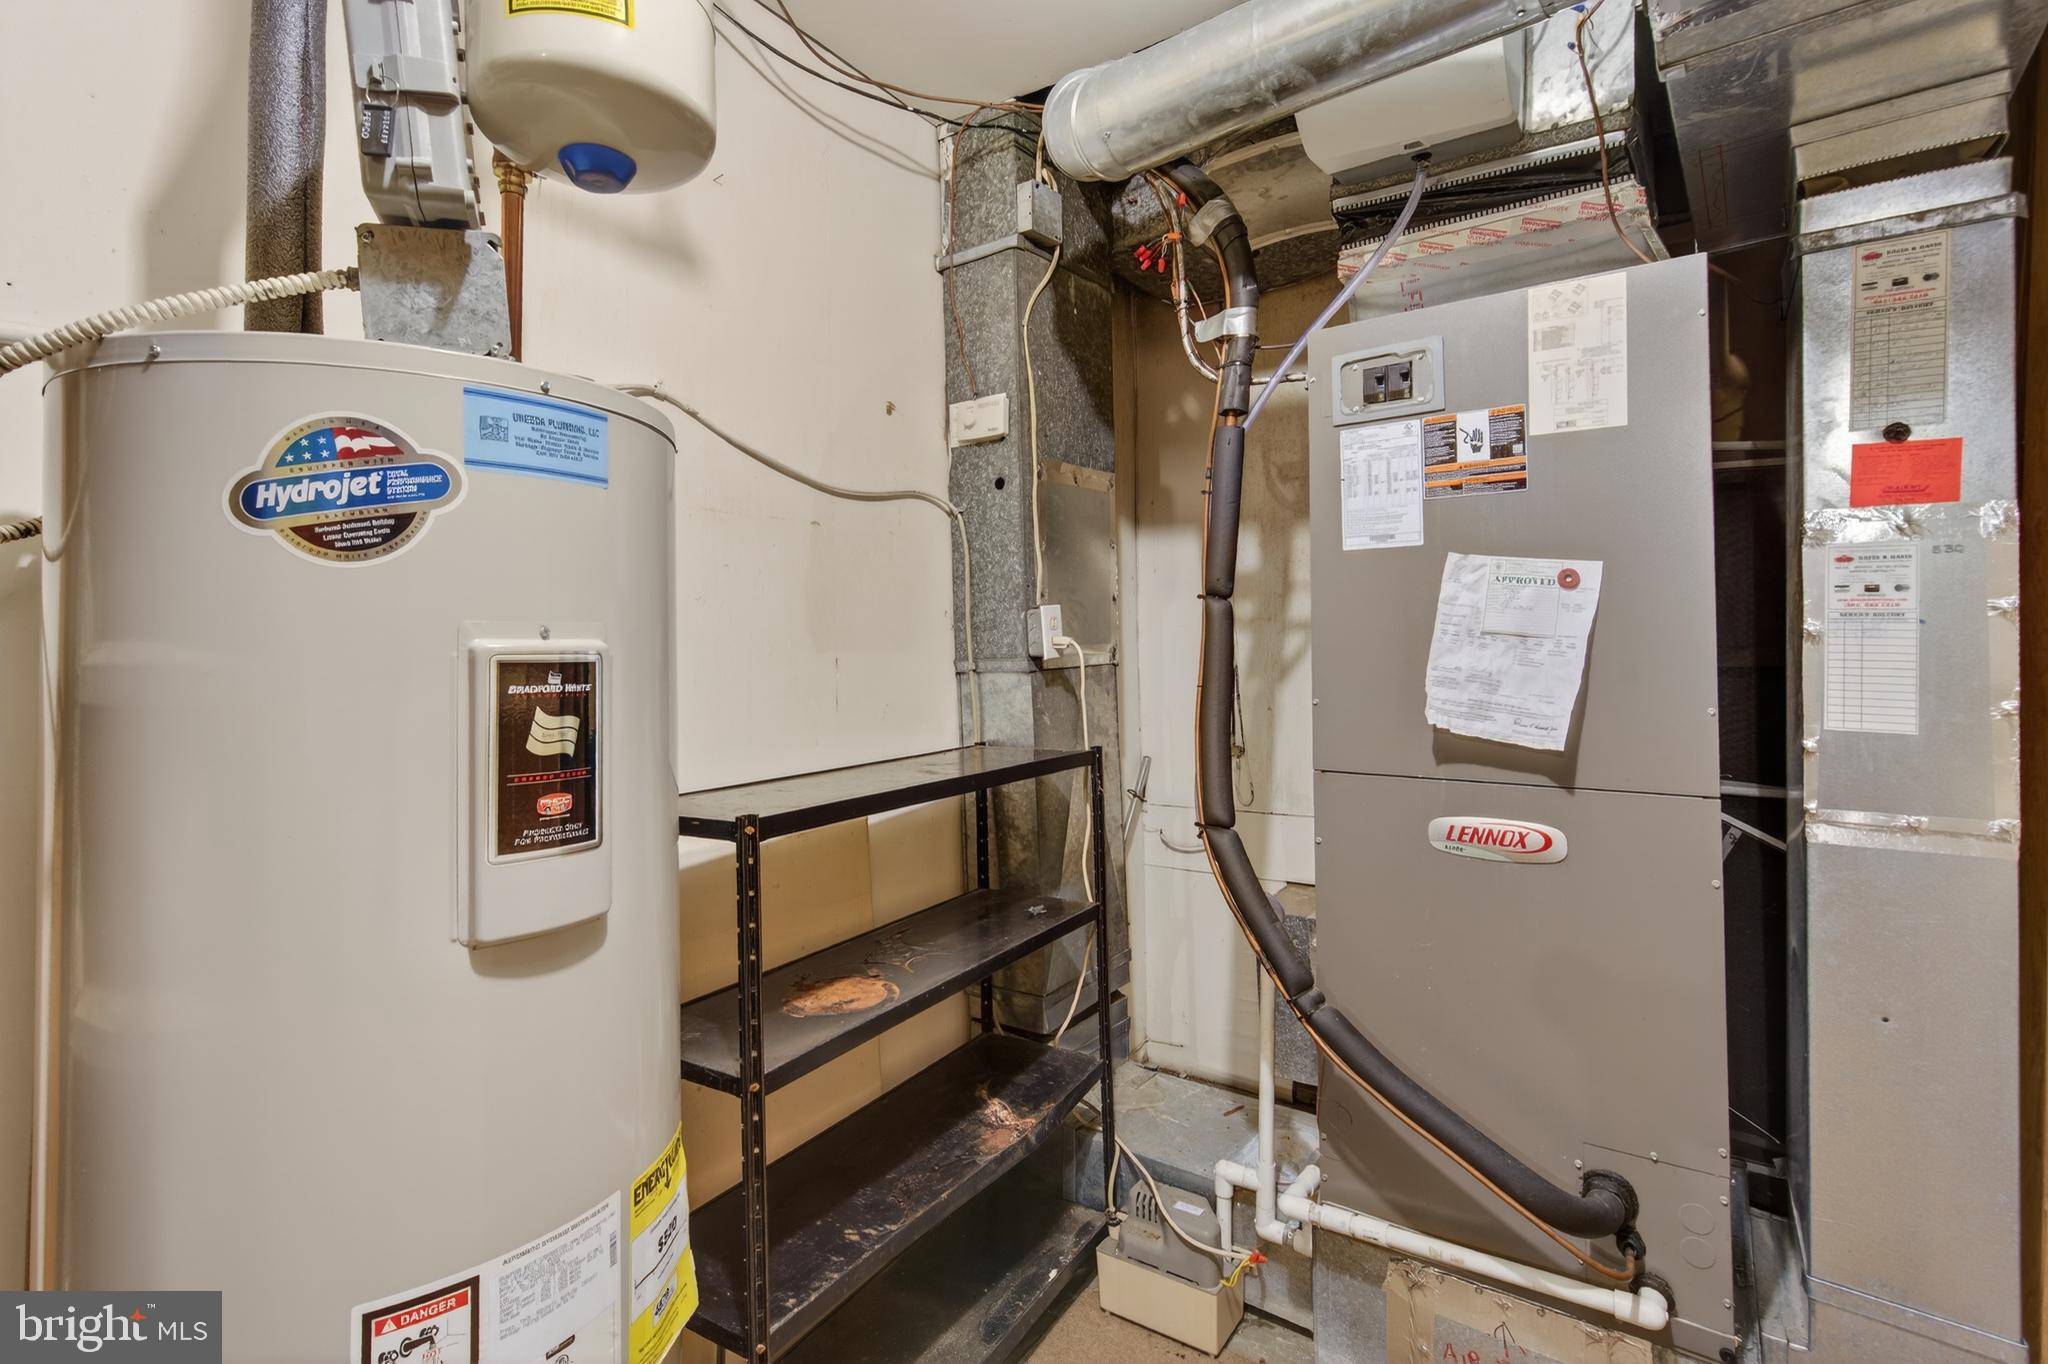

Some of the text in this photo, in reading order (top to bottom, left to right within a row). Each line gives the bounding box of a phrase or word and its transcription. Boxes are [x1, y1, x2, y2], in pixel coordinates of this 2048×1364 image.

[256, 472, 381, 512] Hydrojet
[1445, 824, 1530, 849] LENNOX
[400, 1297, 457, 1326] DANGER
